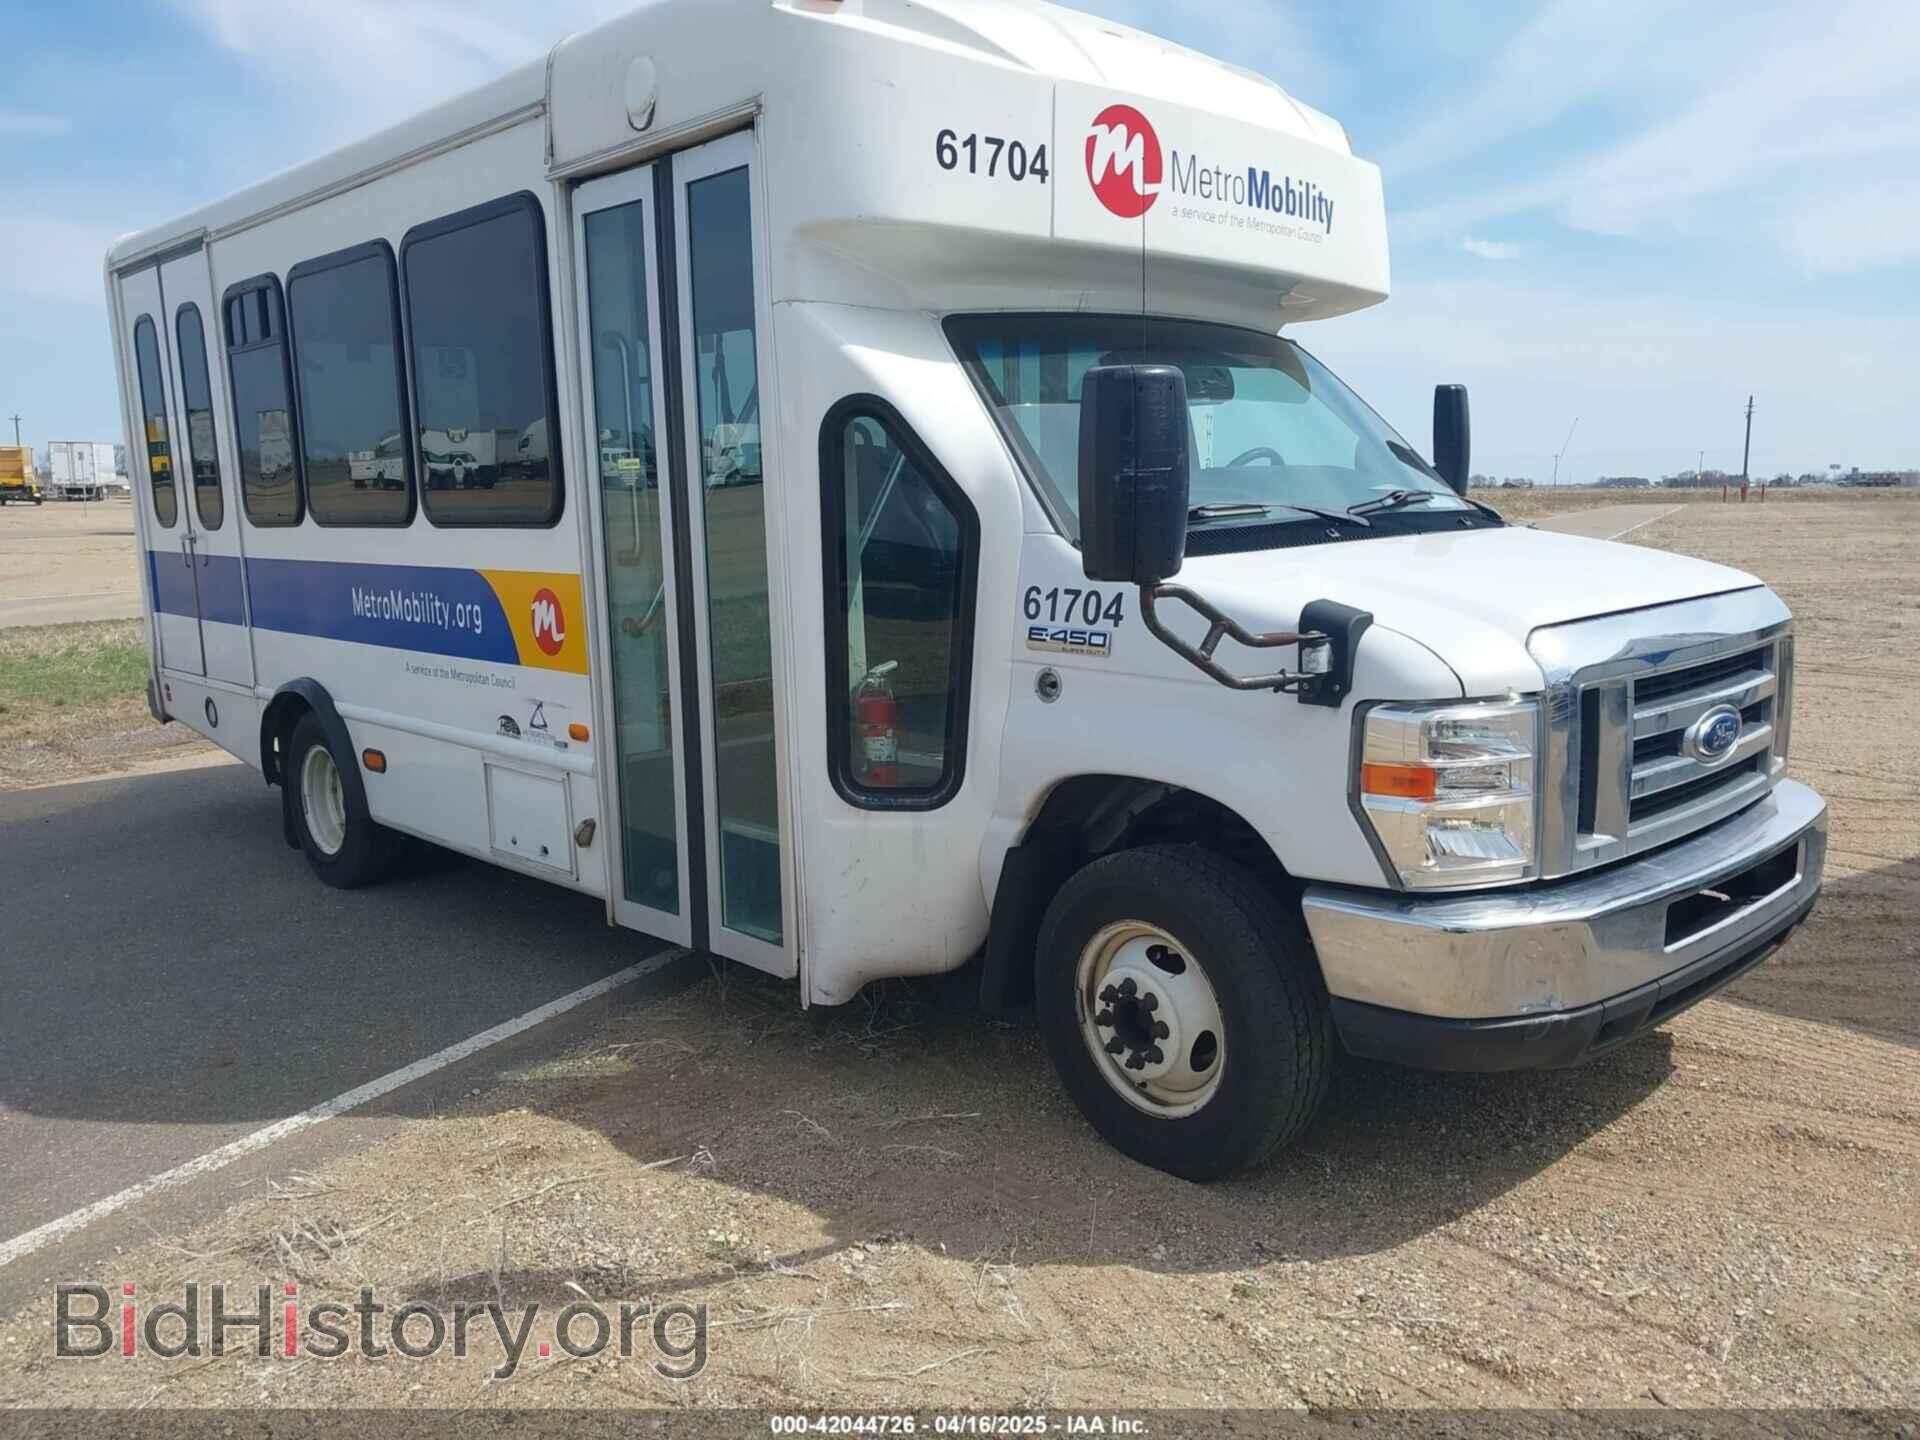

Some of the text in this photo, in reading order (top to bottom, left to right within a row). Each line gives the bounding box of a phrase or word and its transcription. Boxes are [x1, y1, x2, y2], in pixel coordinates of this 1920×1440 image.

[936, 129, 1049, 184] 61704
[1171, 150, 1334, 233] MetroMobility
[1181, 207, 1216, 223] service
[351, 587, 483, 634] MetroMobility.org
[1023, 585, 1124, 628] 61704
